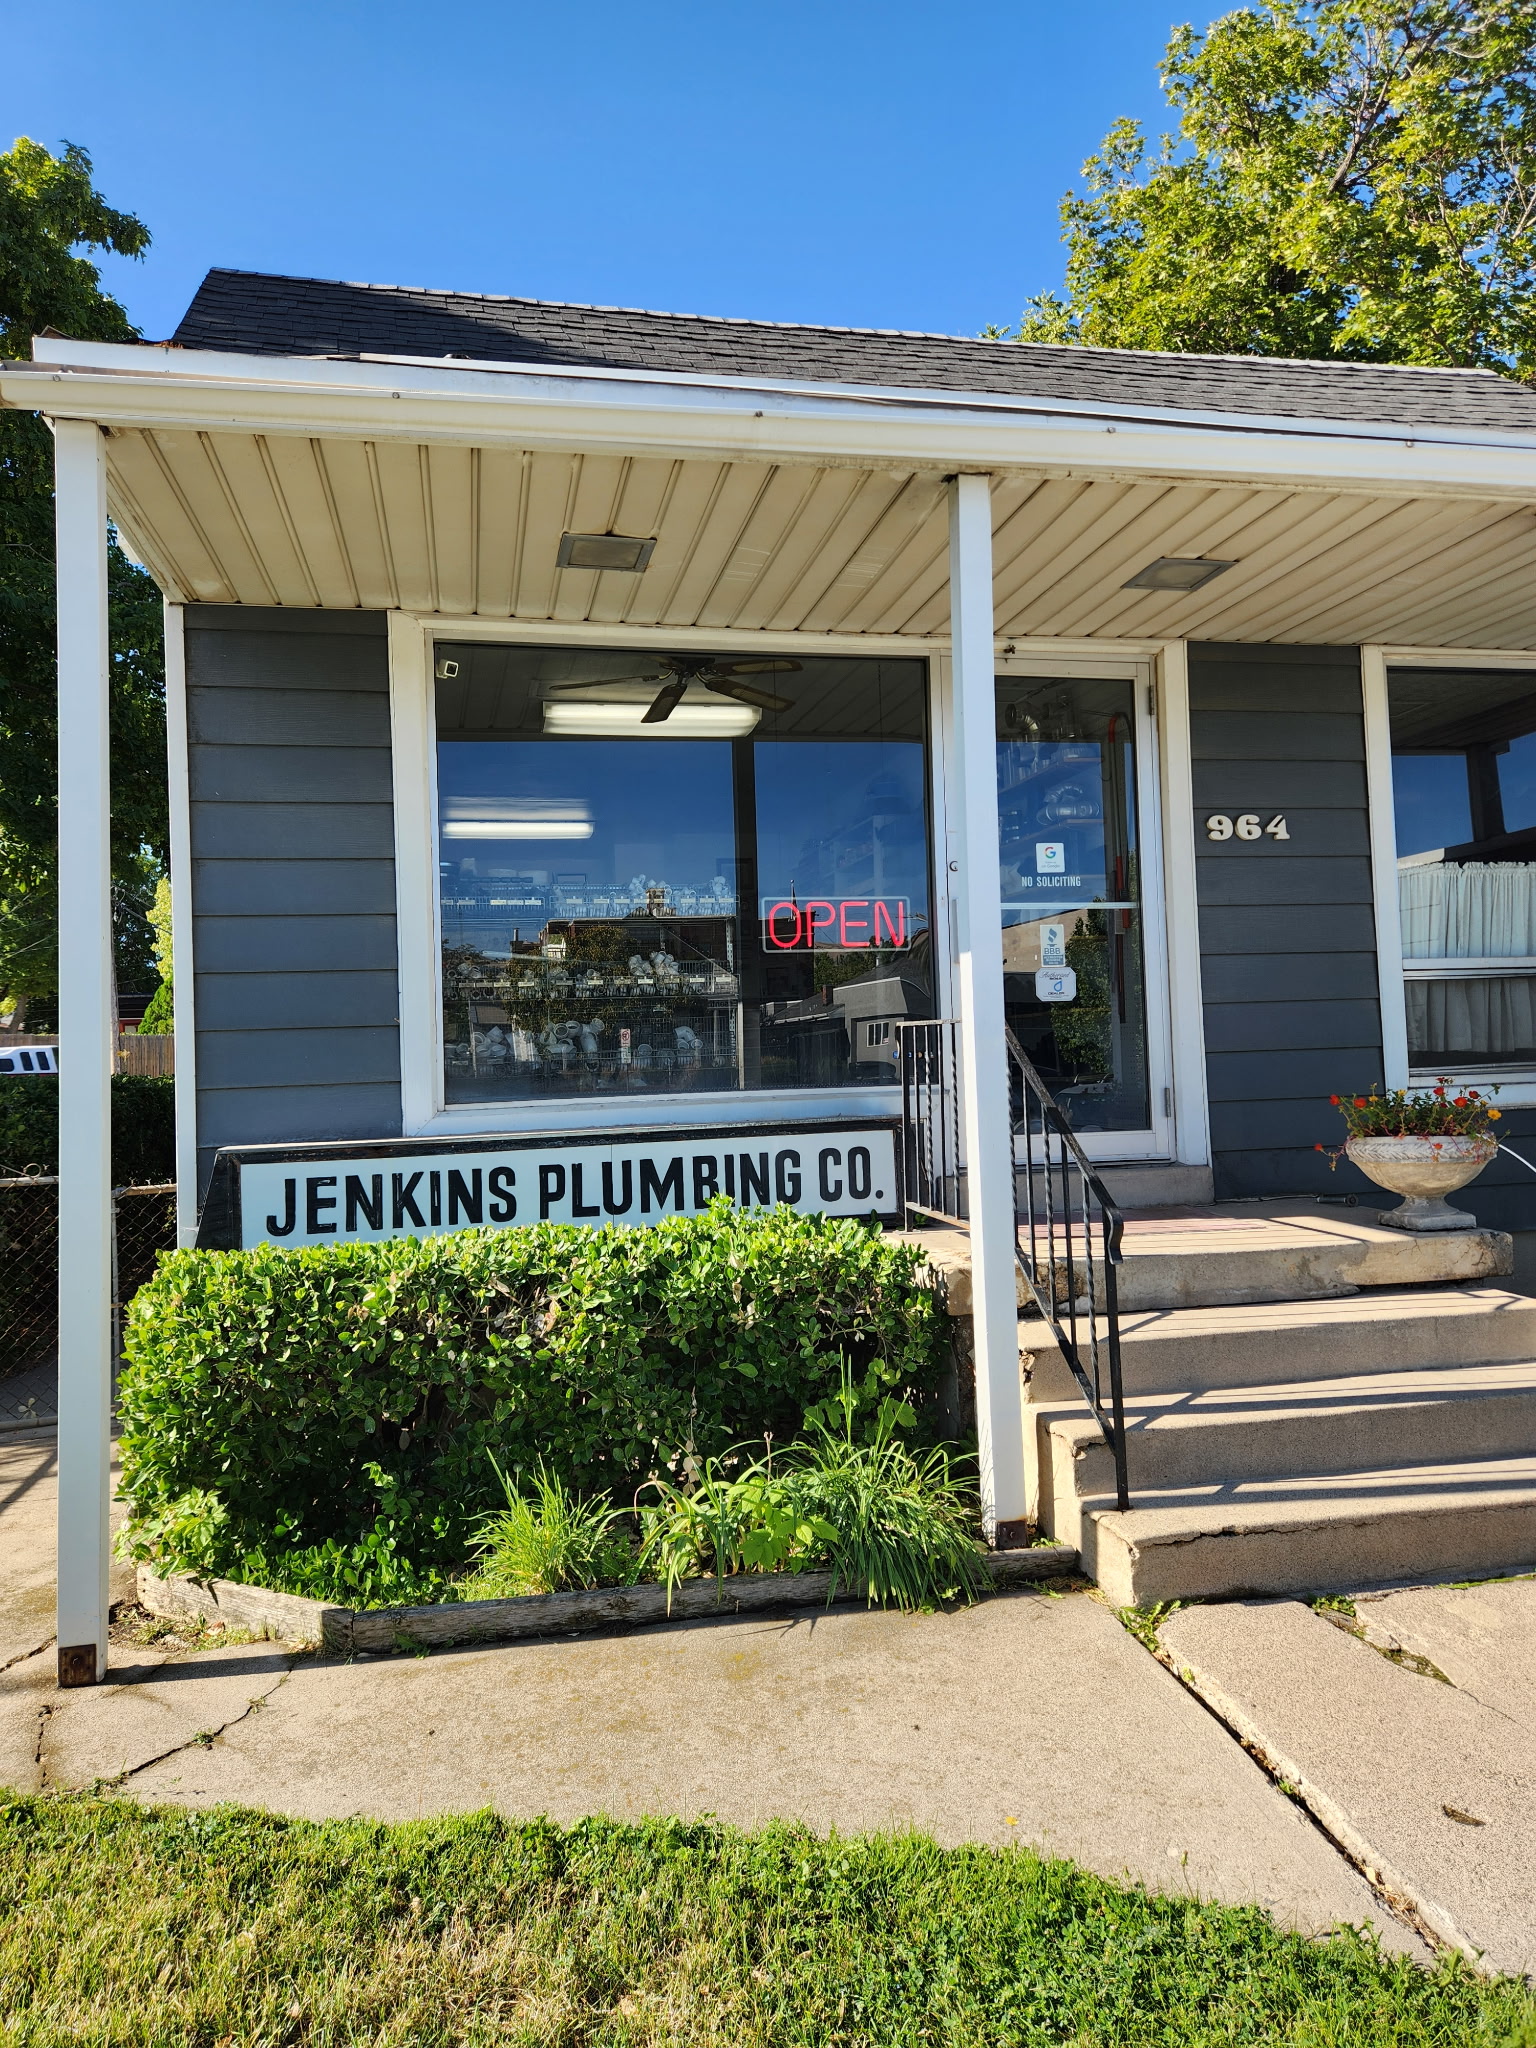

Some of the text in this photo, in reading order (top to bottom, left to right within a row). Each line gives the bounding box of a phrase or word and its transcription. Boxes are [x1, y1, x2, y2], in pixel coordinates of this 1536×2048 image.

[1206, 814, 1290, 841] 964
[1021, 876, 1081, 887] NO SOLICITING
[768, 901, 905, 948] OPEN
[1044, 947, 1061, 955] BBB
[266, 1146, 885, 1237] JENKINS PLUMBING CO.
